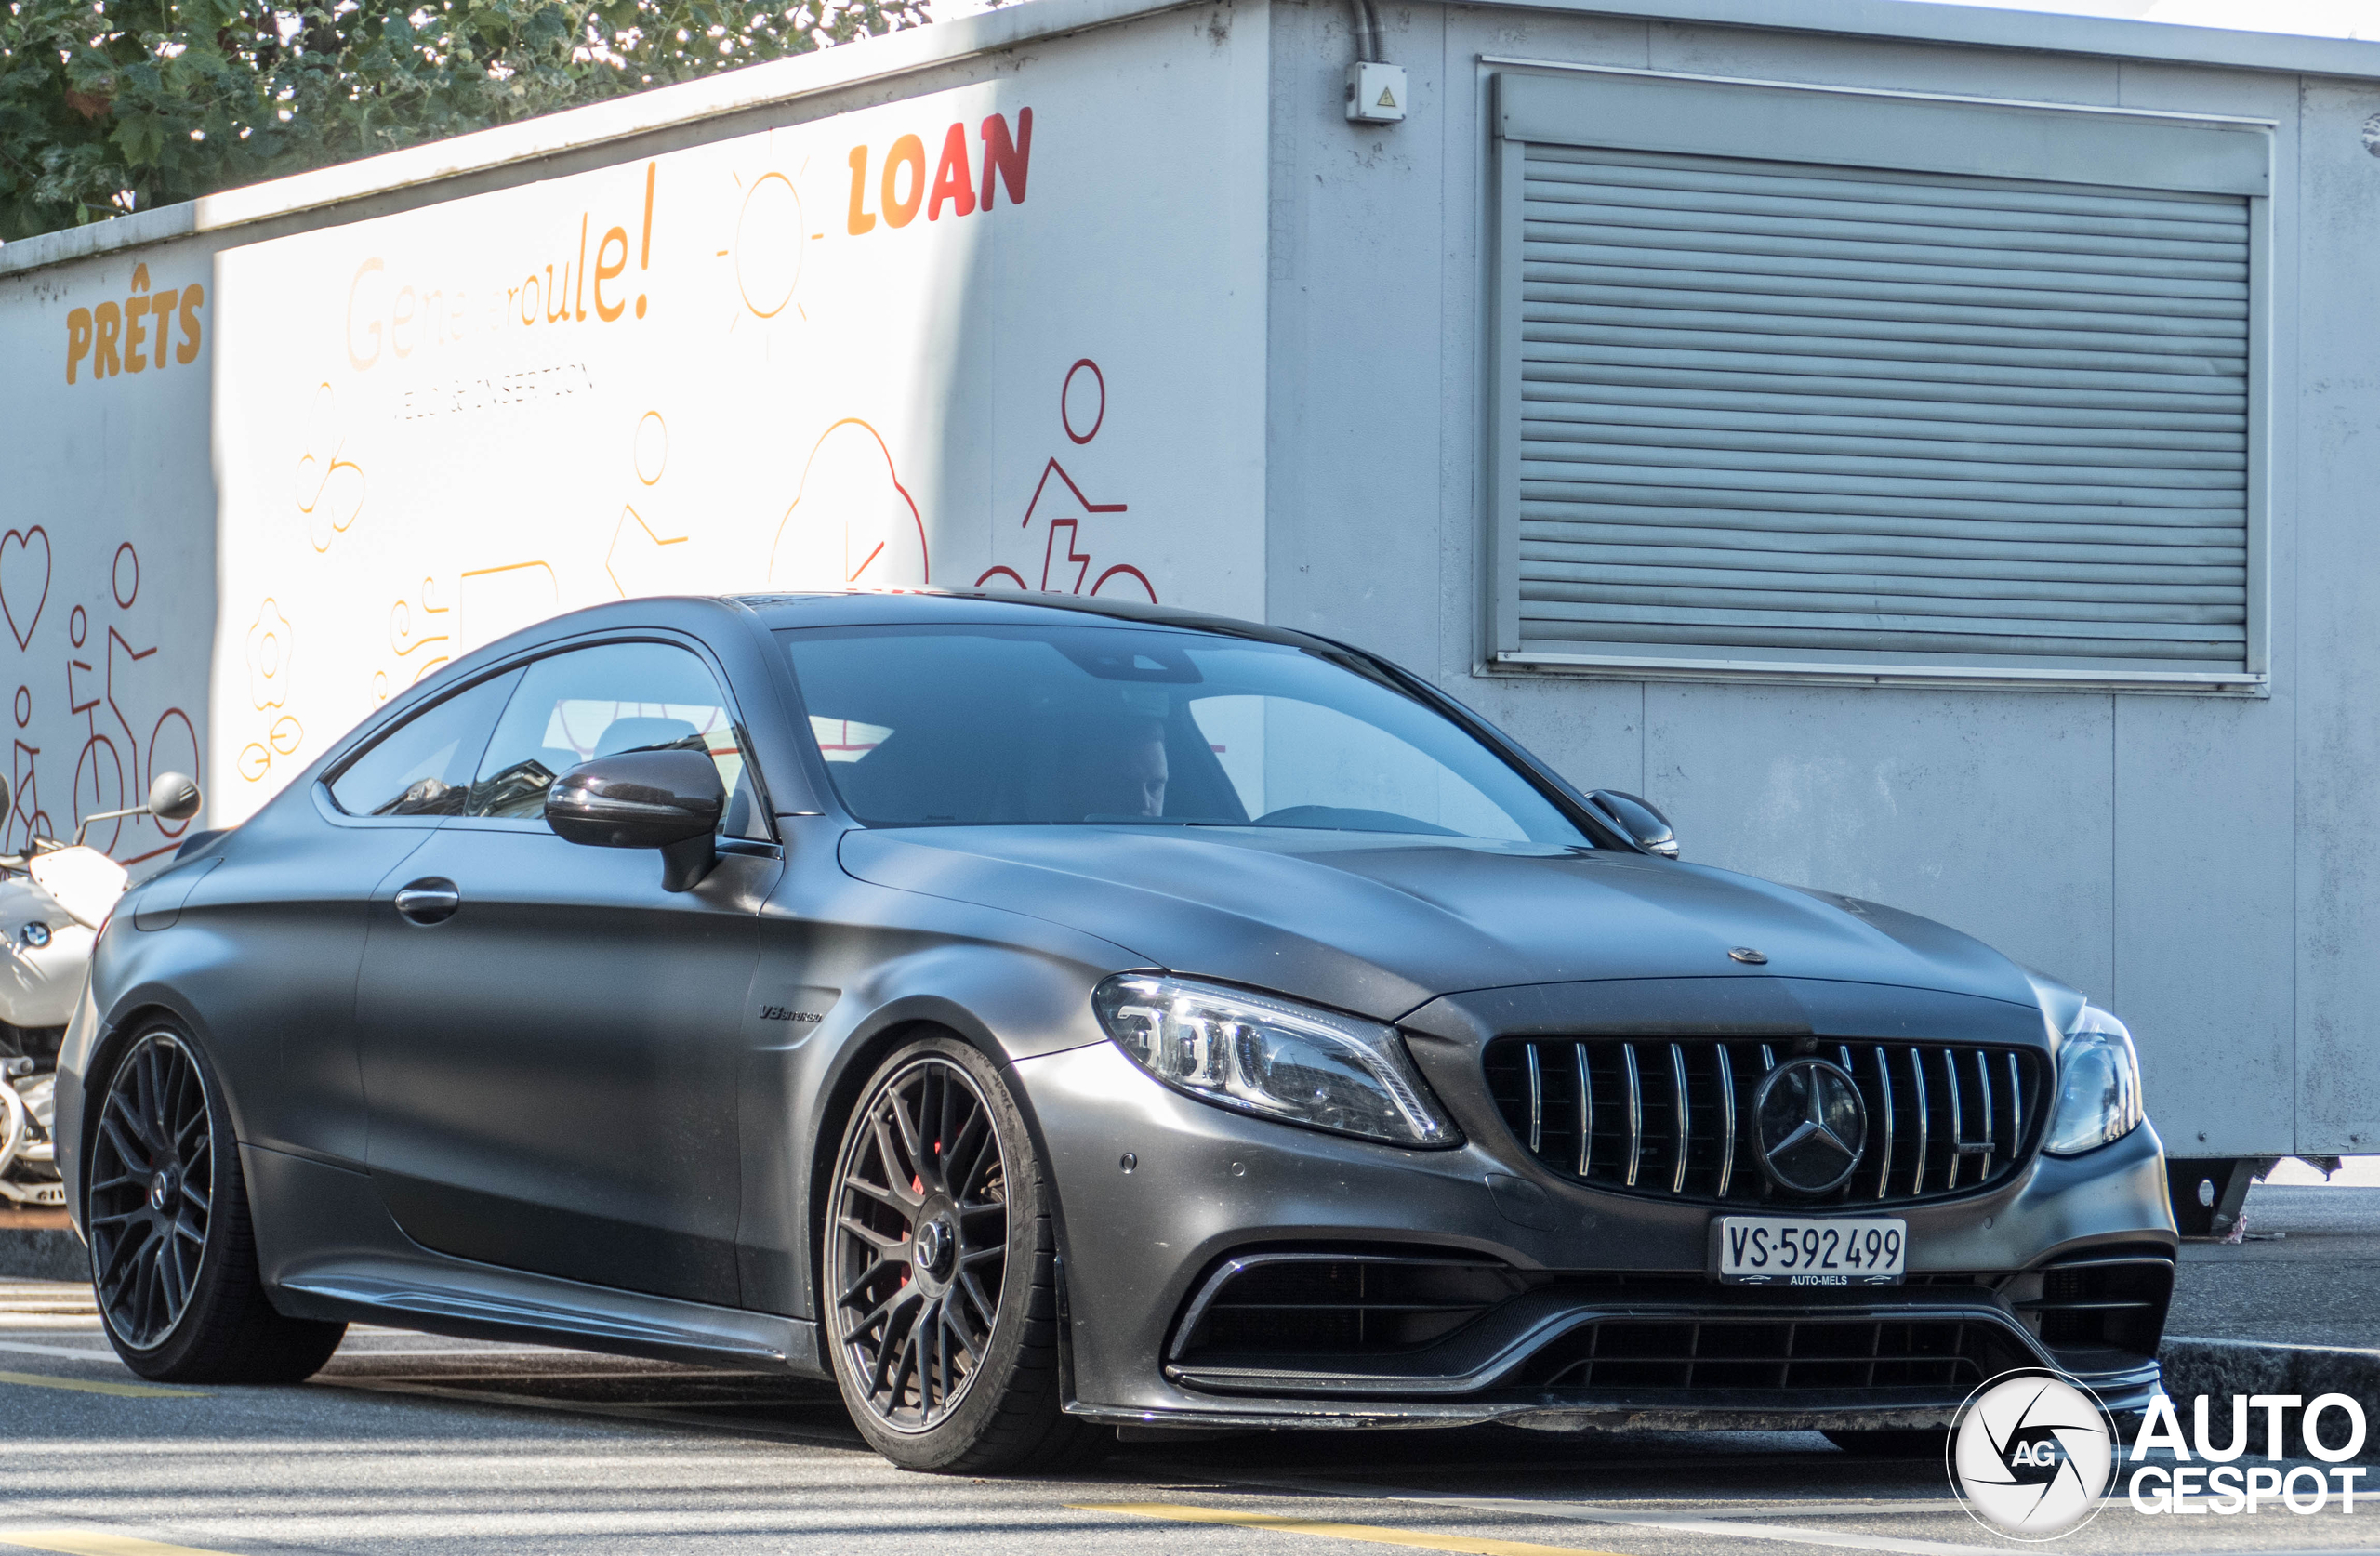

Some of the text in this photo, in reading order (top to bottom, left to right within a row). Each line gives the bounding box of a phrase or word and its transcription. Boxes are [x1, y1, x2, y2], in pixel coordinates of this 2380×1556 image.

[847, 106, 1033, 236] LOAN
[66, 262, 205, 385] PRÊTS
[1790, 1276, 1847, 1286] AUTO-MELS
